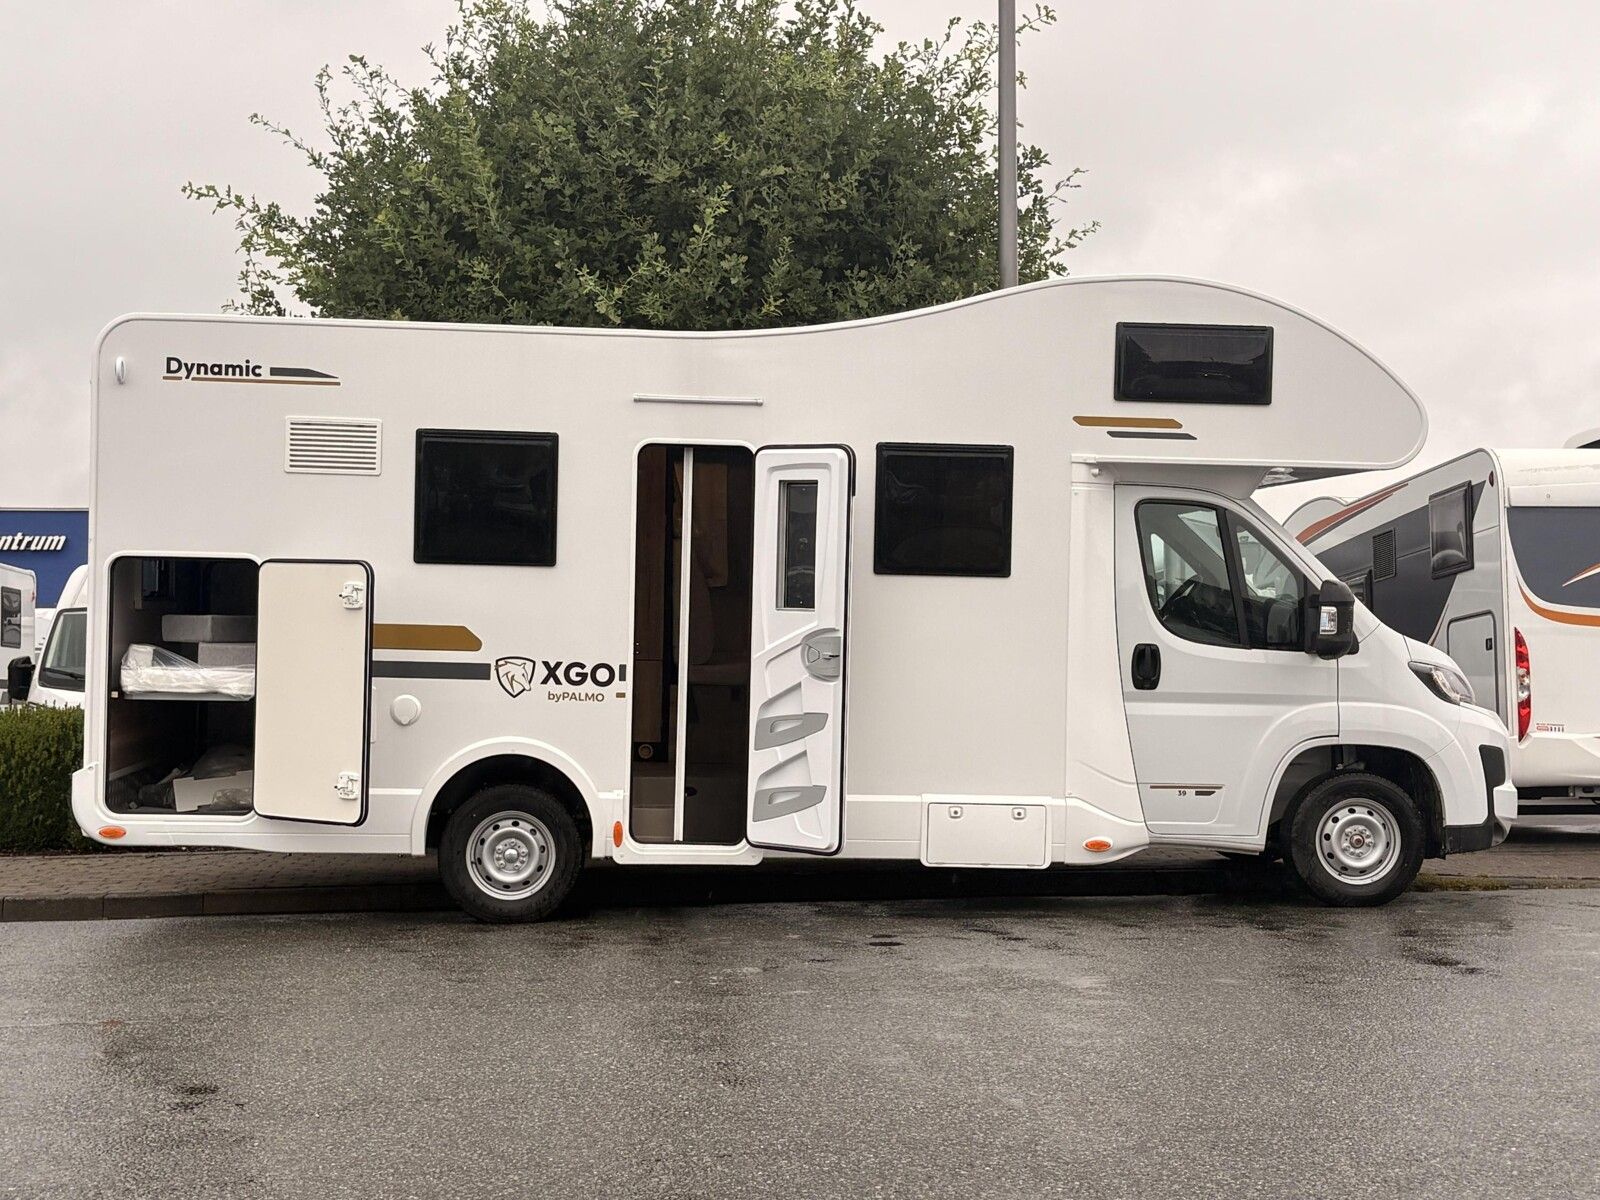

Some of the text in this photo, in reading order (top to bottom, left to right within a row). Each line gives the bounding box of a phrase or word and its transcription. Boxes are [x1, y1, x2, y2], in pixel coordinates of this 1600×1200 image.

[166, 356, 263, 380] Dynamic
[540, 660, 616, 687] XGO
[548, 691, 605, 703] byPALMO
